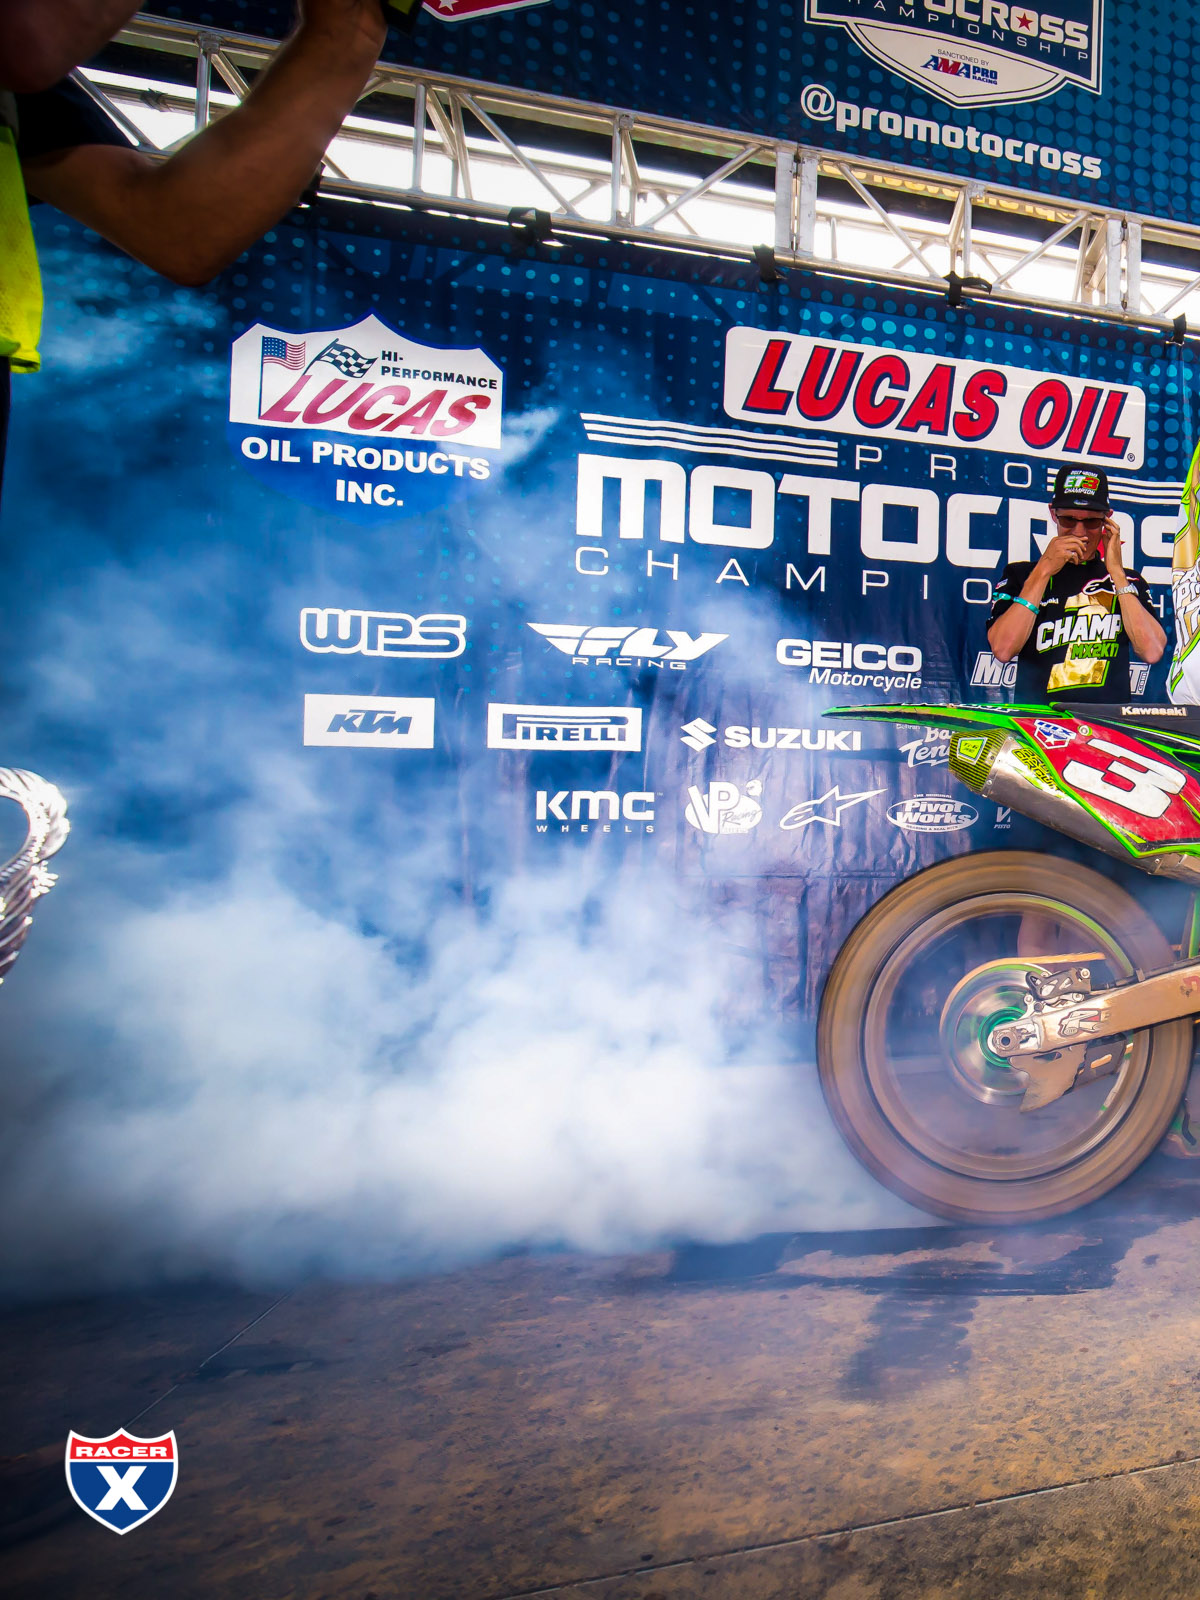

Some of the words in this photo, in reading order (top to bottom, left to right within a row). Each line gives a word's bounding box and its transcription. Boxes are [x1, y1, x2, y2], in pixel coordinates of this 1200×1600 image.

[920, 54, 971, 79] AMA
[972, 65, 998, 80] PRO
[937, 48, 979, 64] SANCTIONED
[800, 83, 1102, 180] @promotocross
[380, 349, 404, 363] HI-
[380, 365, 498, 390] PERFORMANCE
[260, 374, 492, 437] LUCAS
[742, 338, 1008, 442] LUCAS
[1019, 378, 1132, 460] OIL
[241, 436, 301, 464] OIL
[312, 440, 491, 481] PRODUCTS
[854, 444, 1032, 489] PRO
[335, 479, 404, 507] INC.
[1063, 475, 1101, 491] ET3
[1063, 487, 1096, 496] CHAMPION
[300, 607, 467, 658] WPS
[527, 622, 730, 661] FLY
[1036, 613, 1123, 653] CHAMP
[571, 656, 687, 670] RACING
[776, 638, 923, 673] GEICO
[808, 667, 923, 690] Motorcycle
[326, 709, 413, 735] KTM
[1121, 705, 1188, 717] Kawasaki
[502, 712, 629, 742] PIRELLI
[724, 725, 862, 751] SUZUKI
[1062, 738, 1188, 819] 3
[535, 790, 655, 820] KMC
[687, 781, 740, 834] VP
[896, 811, 972, 824] Works
[904, 801, 963, 813] Pivot
[536, 823, 655, 833] WHEELS
